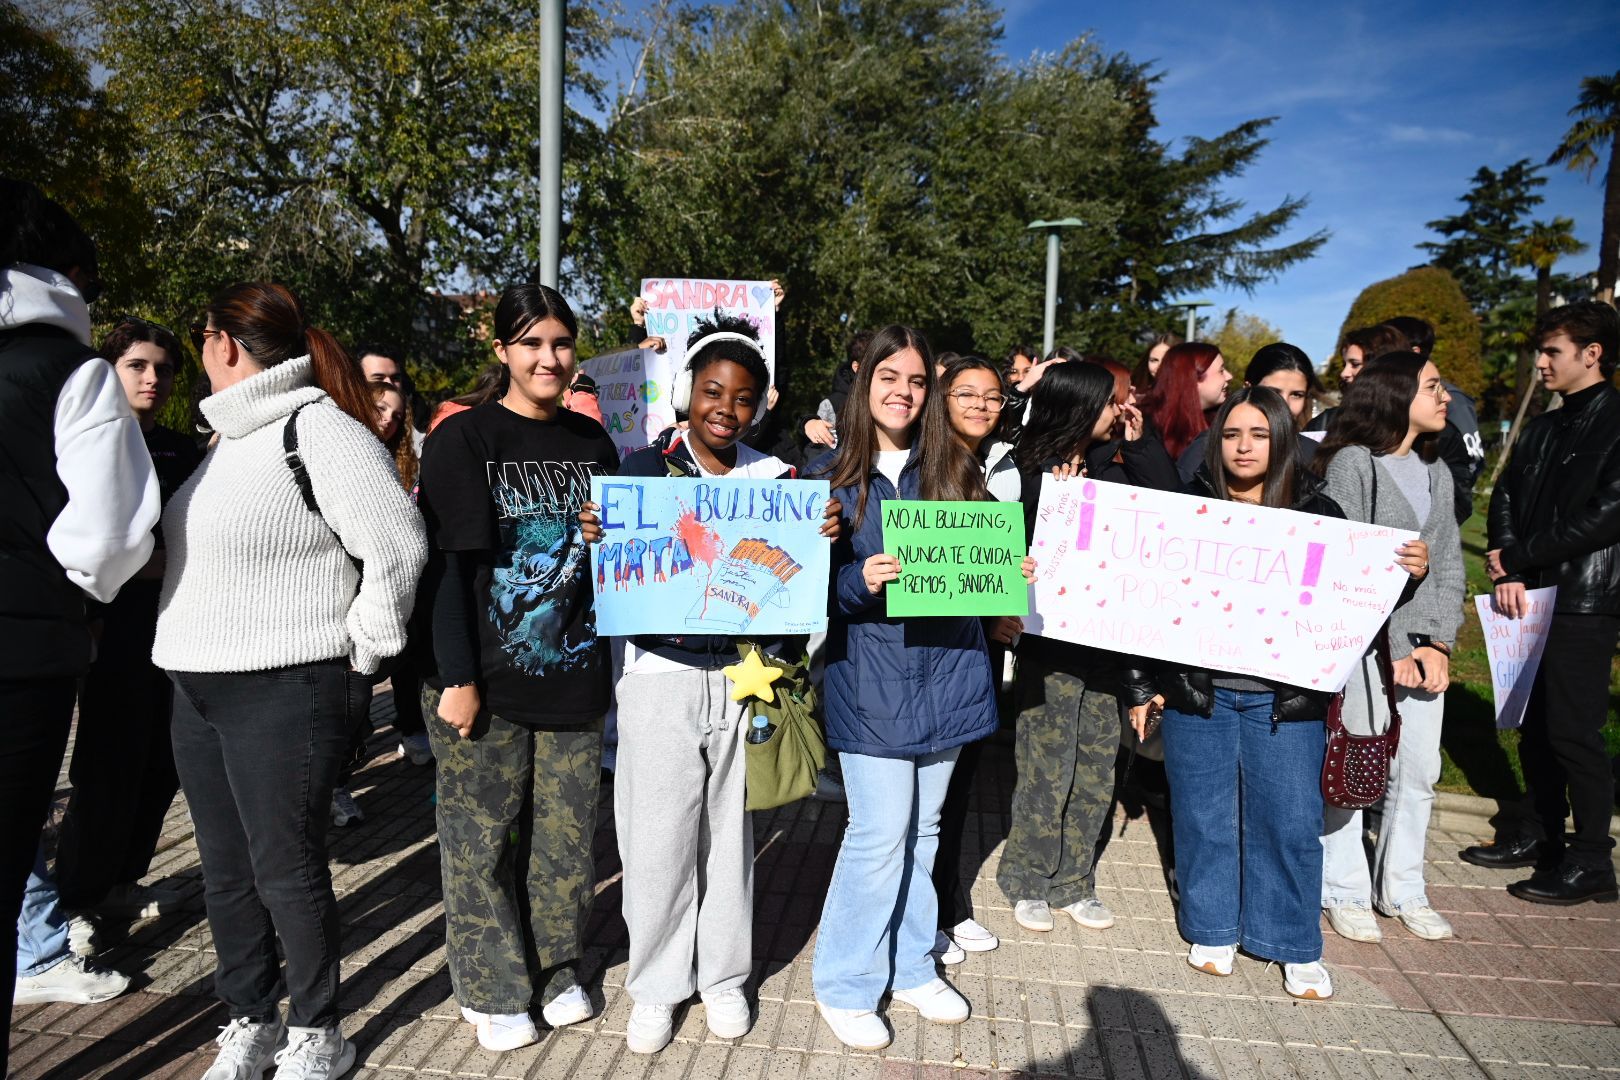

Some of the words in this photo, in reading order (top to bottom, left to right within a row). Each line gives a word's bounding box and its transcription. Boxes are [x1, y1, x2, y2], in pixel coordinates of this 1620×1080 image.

[644, 279, 749, 311] SANDRA
[649, 312, 679, 336] NO
[601, 482, 660, 530] EL
[886, 508, 910, 530] NO
[912, 509, 931, 529] AL
[935, 509, 1012, 533] BULLYING,
[597, 536, 695, 592] MATA
[897, 544, 948, 565] NUNCA
[950, 545, 965, 564] TE
[708, 587, 750, 611] SANDRA
[902, 573, 953, 600] REMOS,
[958, 572, 1009, 595] SANDRA.
[1113, 573, 1183, 609] POR
[1295, 619, 1323, 637] No
